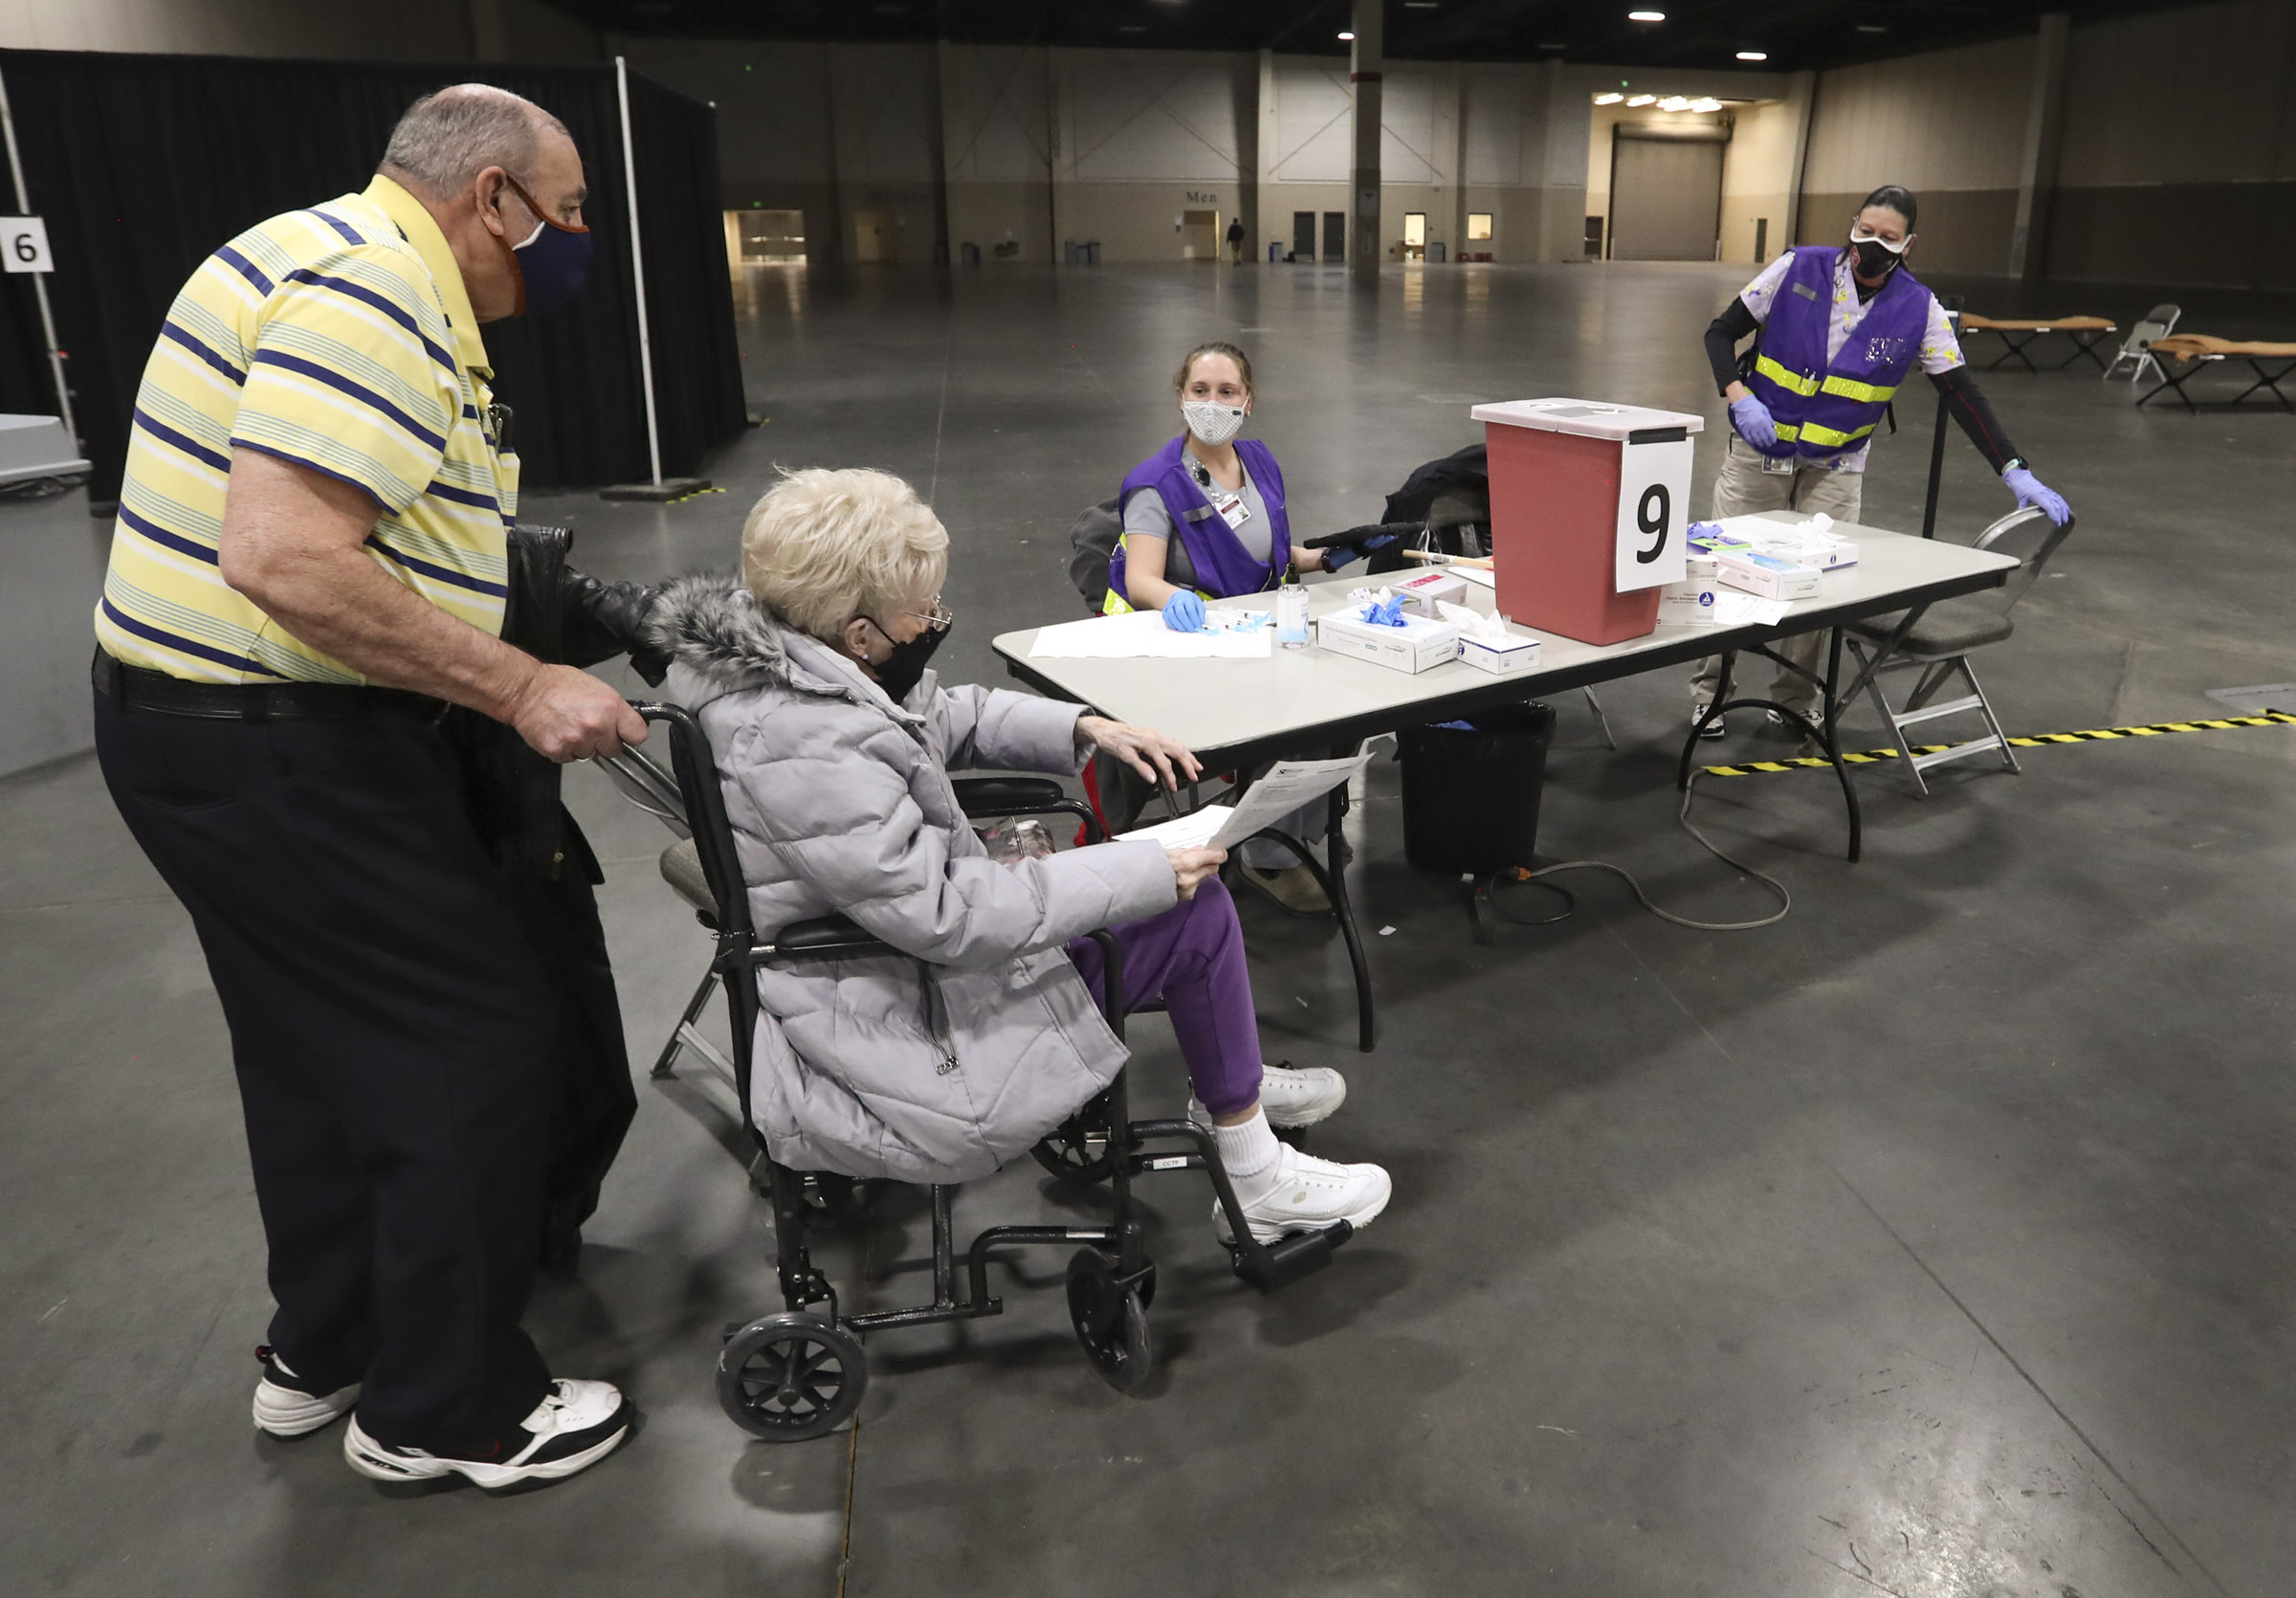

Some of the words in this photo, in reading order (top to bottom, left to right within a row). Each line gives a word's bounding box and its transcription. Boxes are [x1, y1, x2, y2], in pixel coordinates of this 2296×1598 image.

[1186, 191, 1217, 203] Men
[15, 233, 36, 262] 6
[1637, 483, 1669, 564] 9
